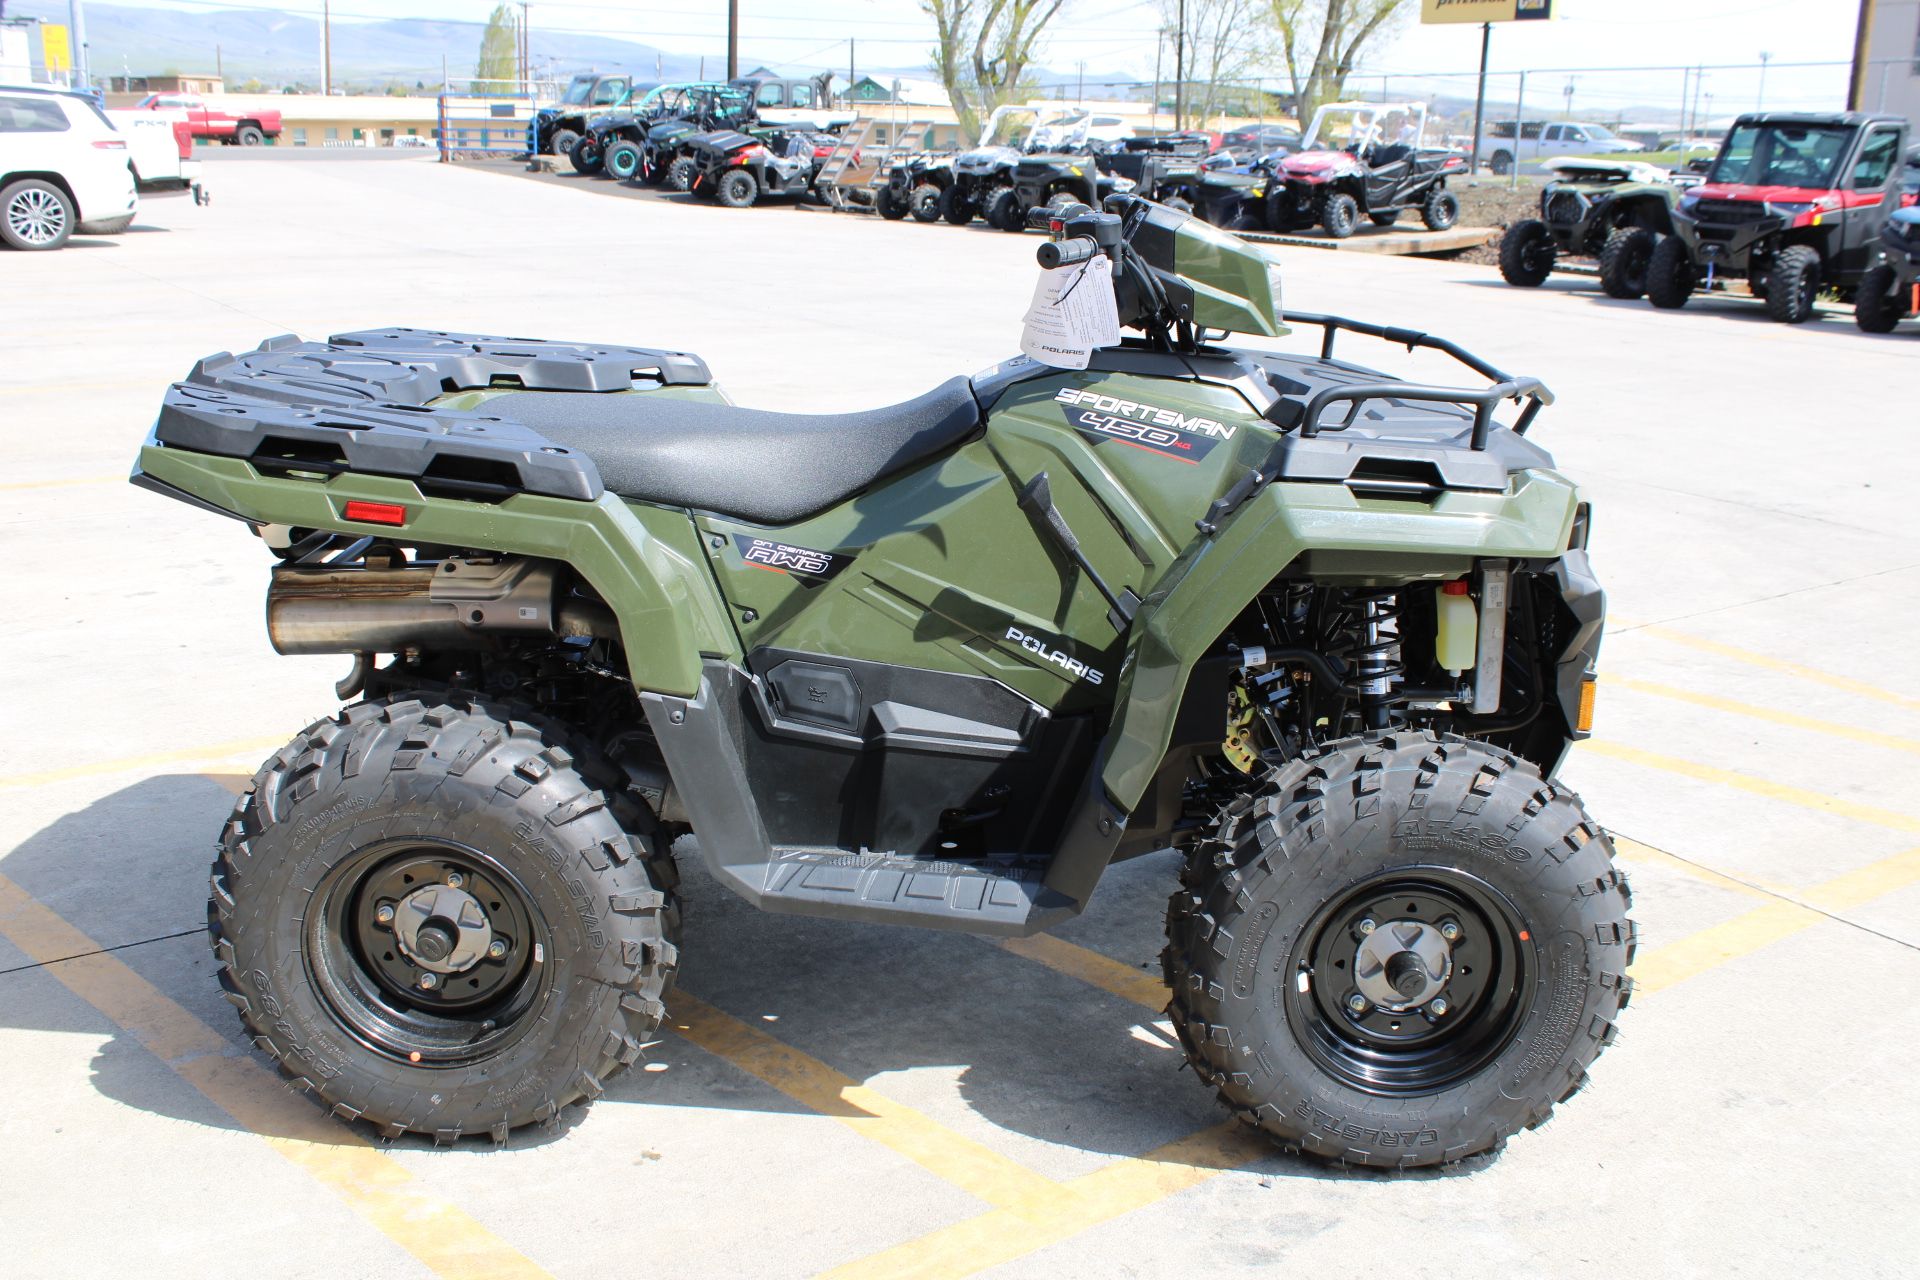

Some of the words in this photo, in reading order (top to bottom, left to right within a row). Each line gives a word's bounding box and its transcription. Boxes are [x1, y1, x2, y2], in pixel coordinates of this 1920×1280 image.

[1041, 344, 1086, 356] POLARIS
[1054, 387, 1238, 440] SPORTSMAN
[1079, 411, 1179, 447] 450
[745, 546, 829, 574] AWD
[777, 545, 832, 560] DEMAND
[1005, 626, 1105, 685] POLARIS
[512, 820, 605, 950] CARLSTAR
[1294, 1097, 1439, 1148] CARLSTAR
